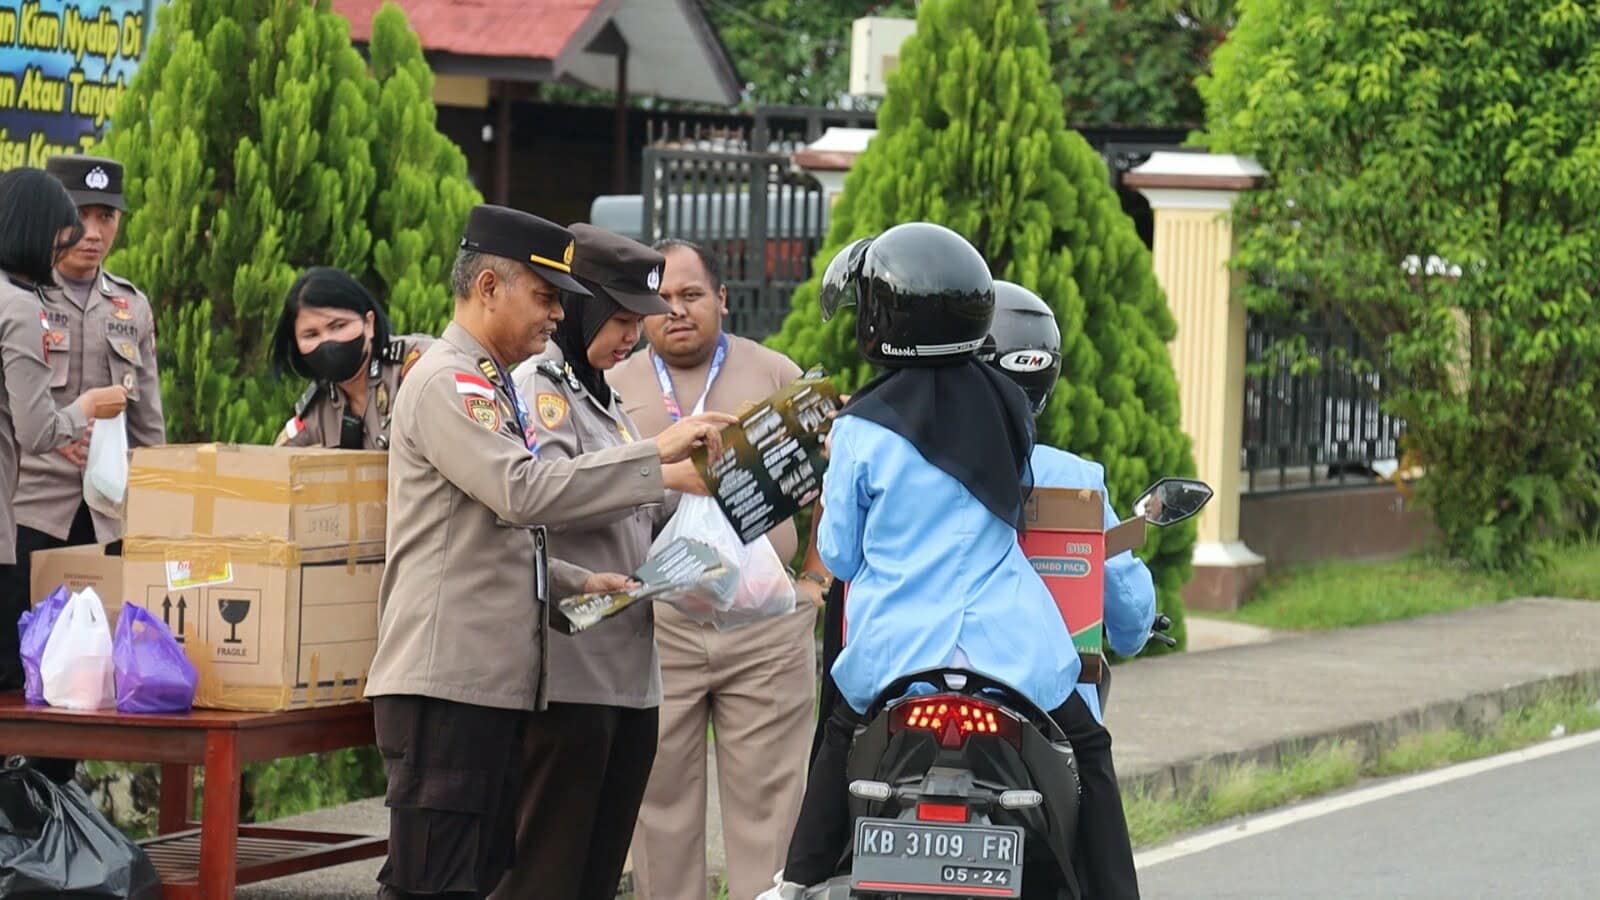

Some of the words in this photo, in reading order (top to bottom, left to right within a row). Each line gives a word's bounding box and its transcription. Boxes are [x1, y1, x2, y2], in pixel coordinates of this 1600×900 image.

[19, 2, 59, 48] Kian
[62, 8, 119, 65] Nyalip
[122, 14, 143, 57] Di
[18, 68, 65, 112] Atau
[881, 342, 917, 357] Classic
[1014, 355, 1045, 367] GM
[1063, 562, 1087, 573] PACK
[217, 647, 247, 657] FRAGILE
[863, 828, 895, 855] KB
[906, 832, 963, 858] 3109
[982, 836, 1012, 861] FR
